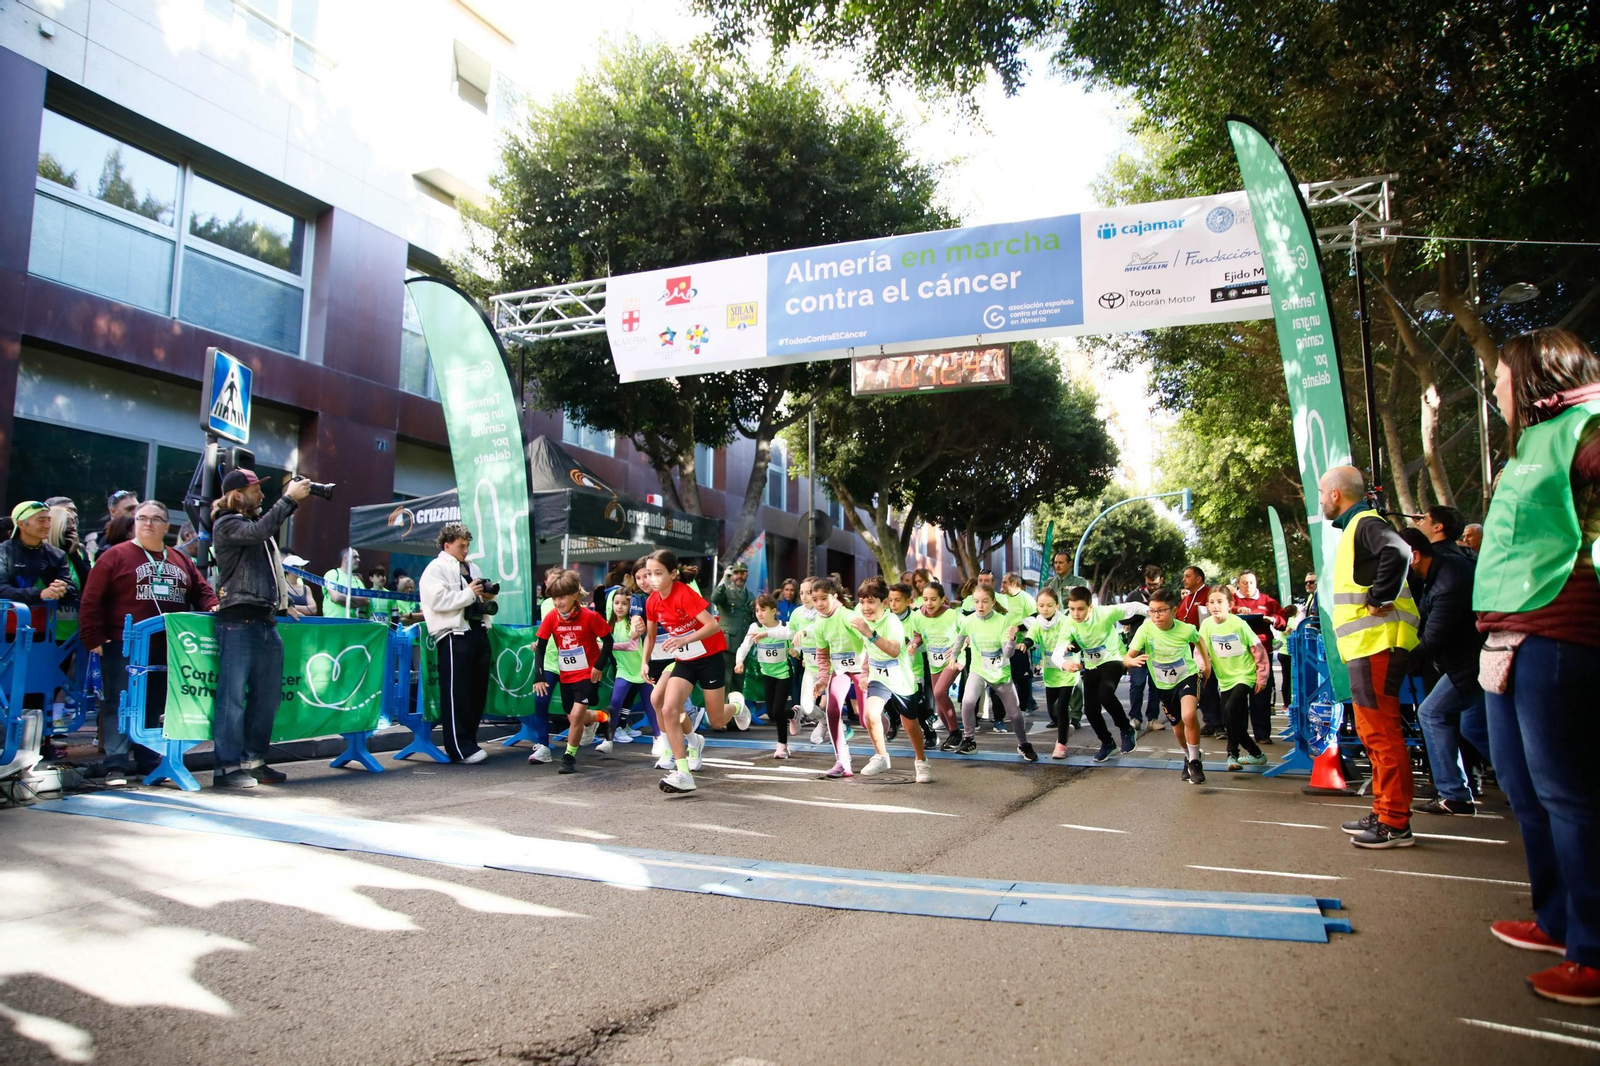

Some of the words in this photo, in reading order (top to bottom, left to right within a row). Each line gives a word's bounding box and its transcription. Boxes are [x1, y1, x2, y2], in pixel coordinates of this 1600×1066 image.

[1121, 218, 1186, 237] cajamar
[785, 250, 892, 285] Almería
[901, 246, 936, 268] en
[945, 231, 1061, 263] marcha
[1124, 263, 1169, 273] MICHELIN
[1184, 247, 1261, 267] Fundación
[1224, 270, 1251, 283] Ejido
[785, 287, 875, 315] contra
[882, 278, 910, 303] el
[917, 270, 1022, 299] cáncer
[1129, 288, 1161, 298] Toyota
[1241, 288, 1258, 296] Jeep
[1008, 301, 1044, 311] asociación
[1044, 298, 1075, 309] española
[1129, 298, 1166, 308] Alborán
[1168, 295, 1196, 304] Motor
[730, 304, 755, 316] SOLAN
[1009, 310, 1031, 318] contra
[1038, 306, 1061, 316] cáncer
[1010, 318, 1020, 326] en
[1019, 315, 1047, 325] Almería
[613, 335, 647, 347] ALMERÍA
[778, 330, 868, 346] #TodosContraElCáncer
[1218, 642, 1232, 651] 76
[765, 649, 778, 657] 66
[933, 653, 944, 661] 64
[1088, 652, 1101, 660] 79
[563, 656, 577, 665] 68
[841, 658, 855, 667] 65
[876, 667, 890, 677] 71
[1161, 668, 1178, 678] 74
